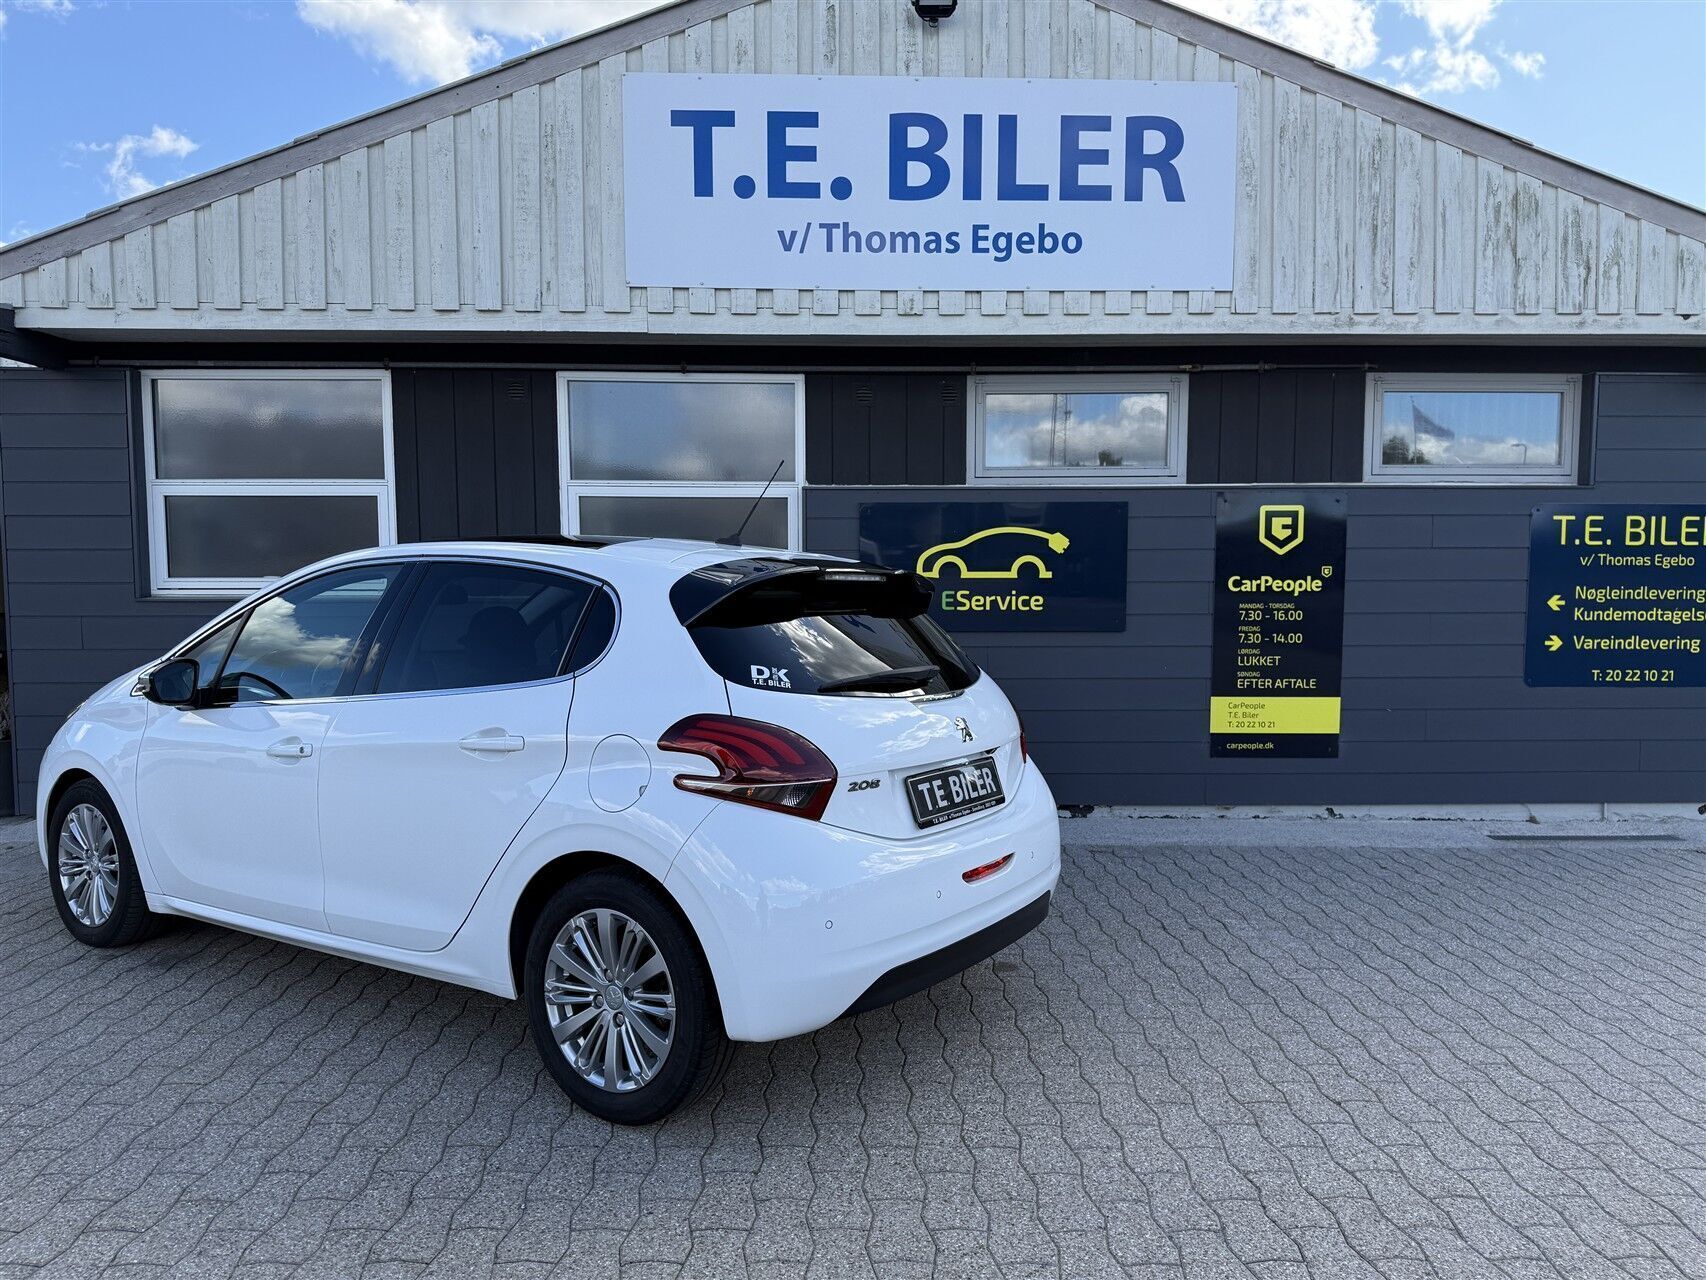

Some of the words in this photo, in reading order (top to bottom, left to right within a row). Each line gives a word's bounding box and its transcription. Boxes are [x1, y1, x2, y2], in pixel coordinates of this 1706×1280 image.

[670, 109, 853, 201] T.E.
[888, 111, 1187, 203] BILER
[777, 222, 812, 253] v/
[819, 221, 961, 254] Thomas
[972, 223, 1083, 263] Egebo
[1552, 515, 1612, 546] T.E.
[1625, 515, 1706, 546] BILE
[1597, 553, 1651, 567] Thomas
[1654, 553, 1695, 569] Egebo
[1227, 575, 1323, 597] CarPeople
[941, 590, 1044, 611] EService
[1575, 585, 1706, 604] Nøgleindlevering
[1239, 610, 1263, 621] 7.30
[1273, 610, 1303, 621] 16.00
[1574, 607, 1706, 625] Kundemodtagels
[1238, 633, 1262, 643] 7.30
[1272, 633, 1303, 643] 14.00
[1573, 635, 1701, 653] Vareindlevering
[1237, 656, 1281, 666] LUKKET
[750, 665, 791, 682] DK
[1591, 670, 1603, 682] T:
[1605, 669, 1622, 682] 20
[1625, 669, 1641, 682] 22
[1643, 669, 1658, 682] 10
[1660, 669, 1674, 682] 21
[768, 680, 791, 688] BILER
[1237, 678, 1273, 689] EFTER
[1274, 678, 1317, 689] AFTALE
[1227, 701, 1266, 710] CarPeople
[1228, 711, 1241, 719] T.E.
[1242, 711, 1259, 719] Biler
[1226, 742, 1275, 751] carpeople.dk
[847, 778, 881, 792] 208
[948, 767, 997, 804] BILER
